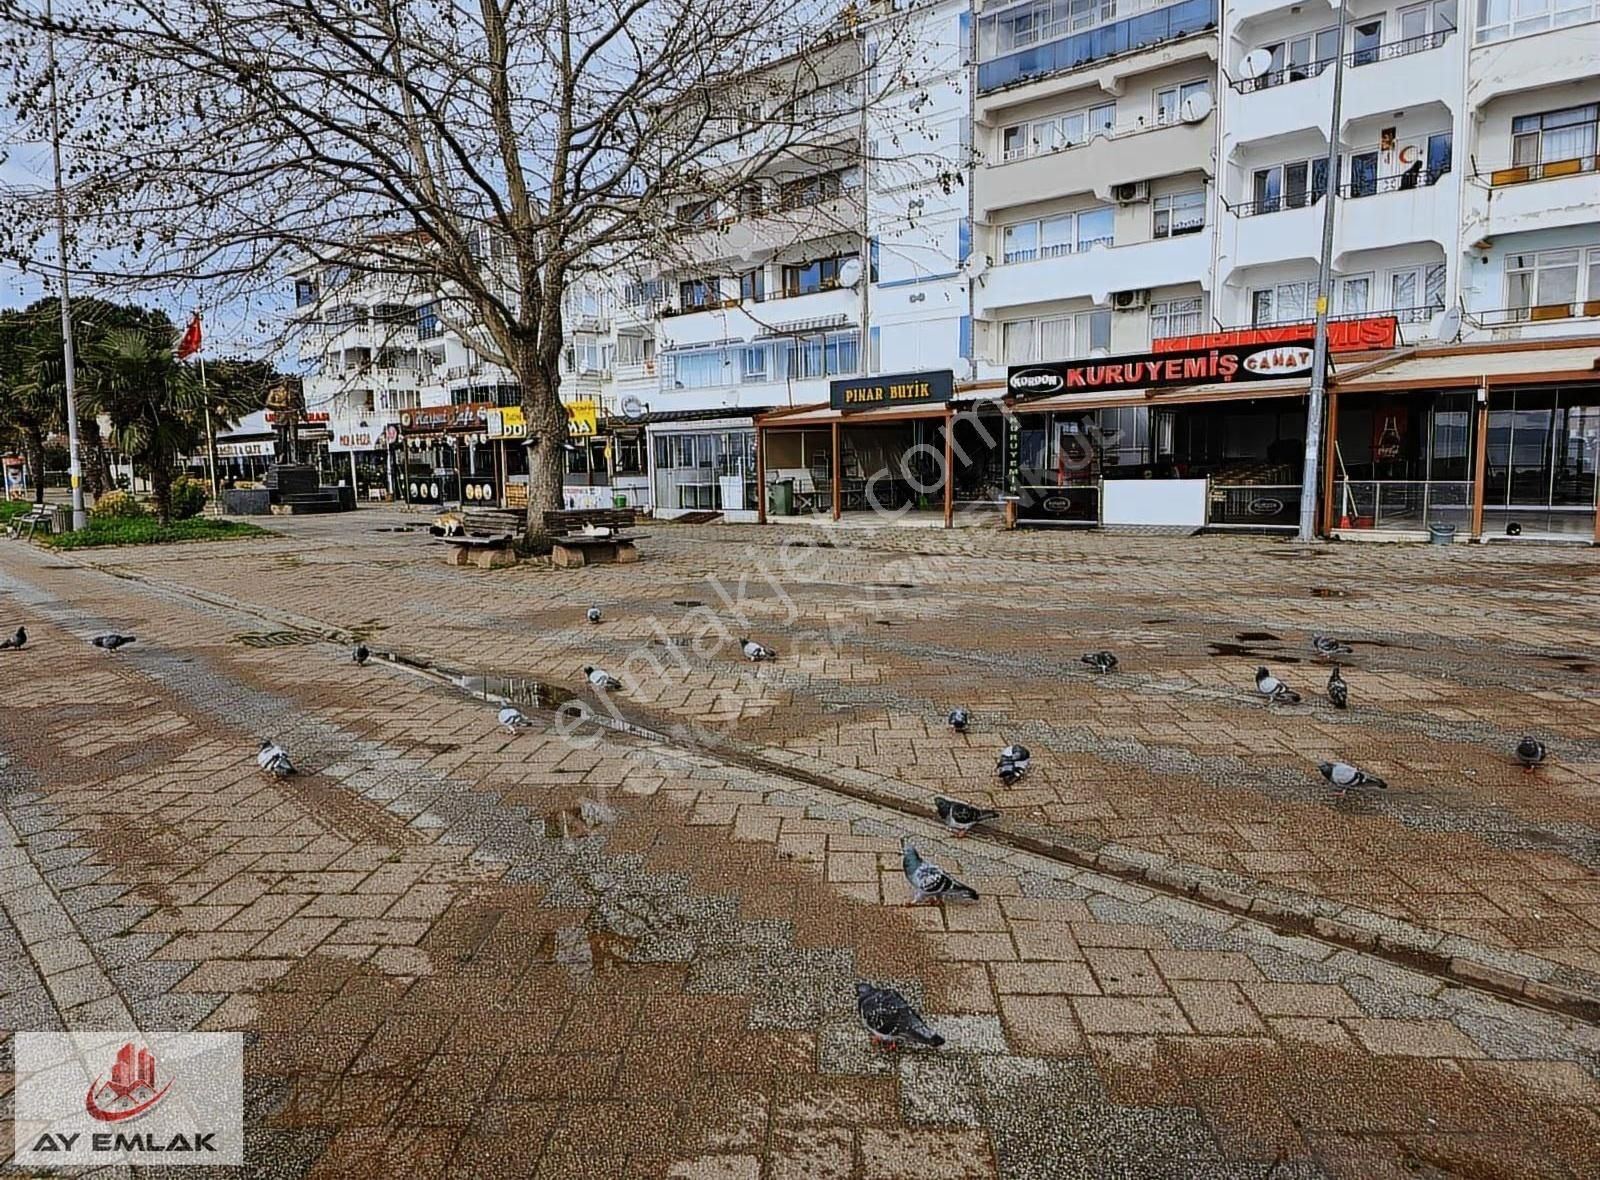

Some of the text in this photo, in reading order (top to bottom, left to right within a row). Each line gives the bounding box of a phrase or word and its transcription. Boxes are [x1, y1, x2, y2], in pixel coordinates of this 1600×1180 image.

[1066, 350, 1239, 387] KURUYEMİŞ
[1013, 374, 1058, 388] KORDON
[845, 382, 931, 403] PINAR BUTİK
